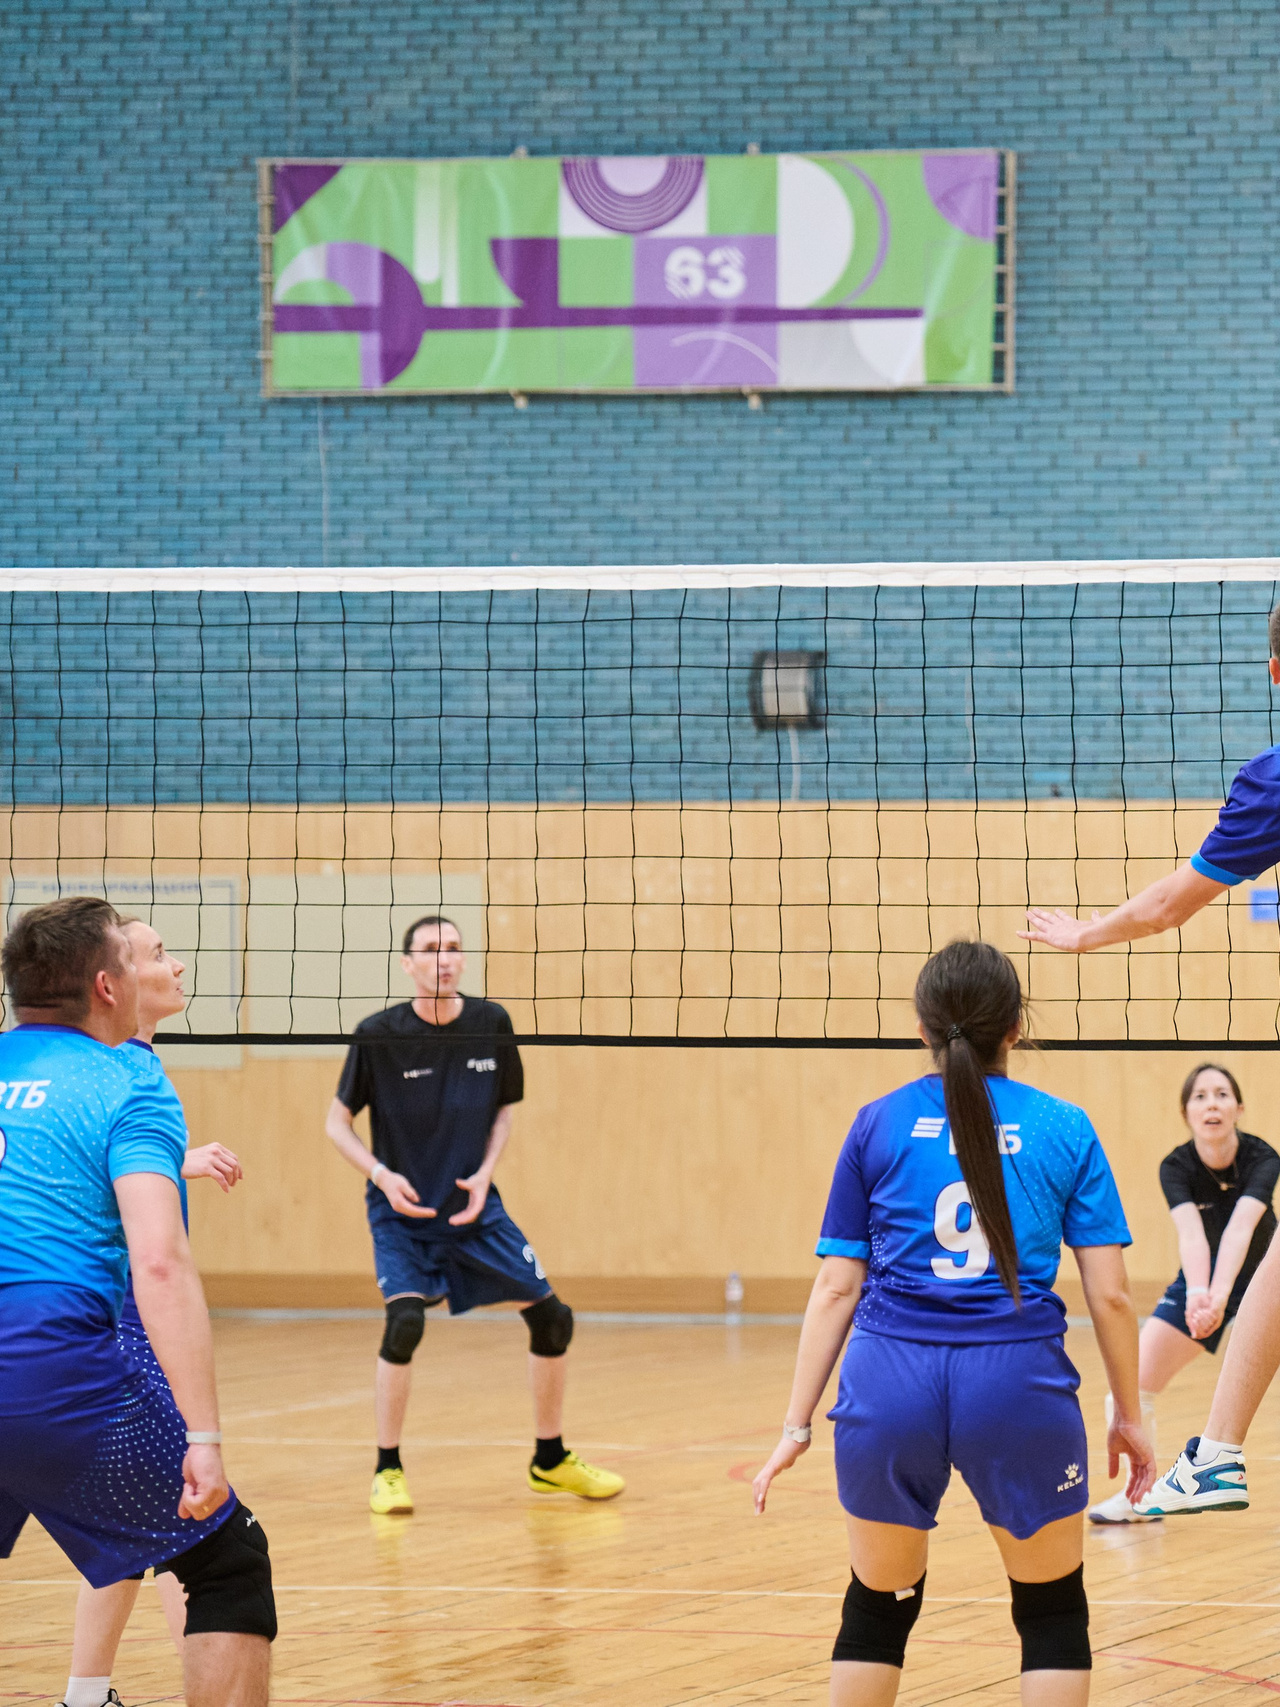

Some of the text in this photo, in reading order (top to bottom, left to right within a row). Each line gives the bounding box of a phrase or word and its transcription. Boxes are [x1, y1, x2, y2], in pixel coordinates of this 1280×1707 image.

[665, 246, 746, 299] 63
[931, 1181, 990, 1280] 9
[1057, 1474, 1084, 1493] KELM
